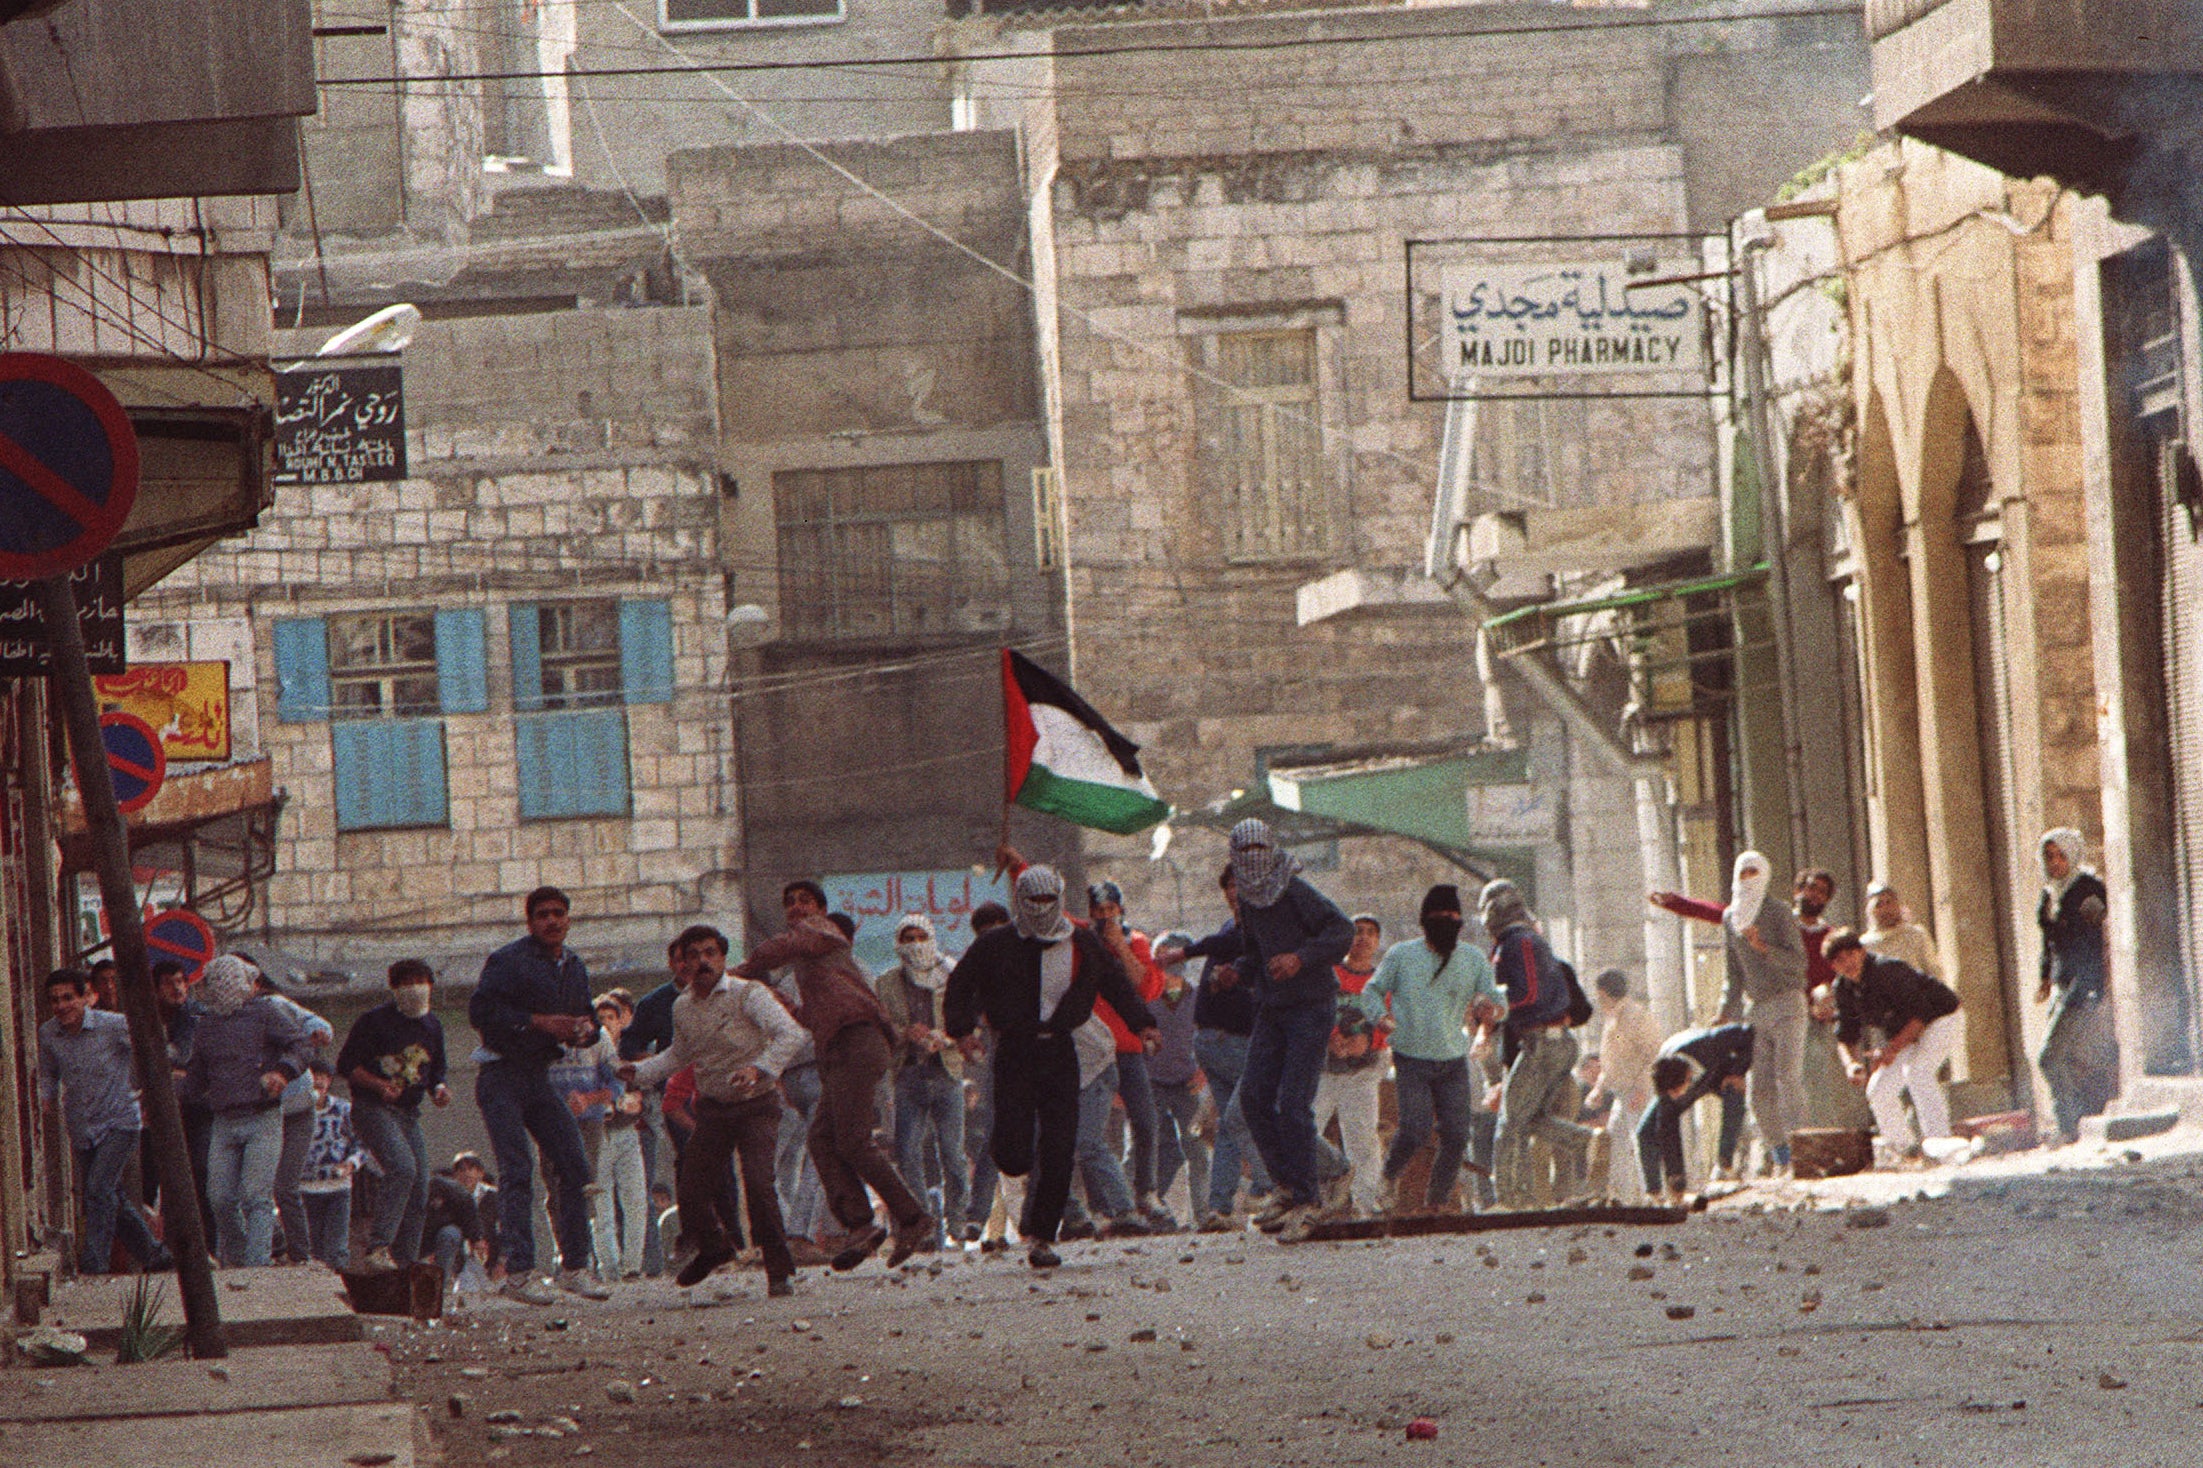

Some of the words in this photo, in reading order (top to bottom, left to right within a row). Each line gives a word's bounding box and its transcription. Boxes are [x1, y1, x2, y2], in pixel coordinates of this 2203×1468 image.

[1451, 282, 1559, 333] مجدي
[1561, 270, 1690, 333] صيدلية
[1459, 339, 1535, 366] MAJDI
[1548, 336, 1681, 364] PHARMACY
